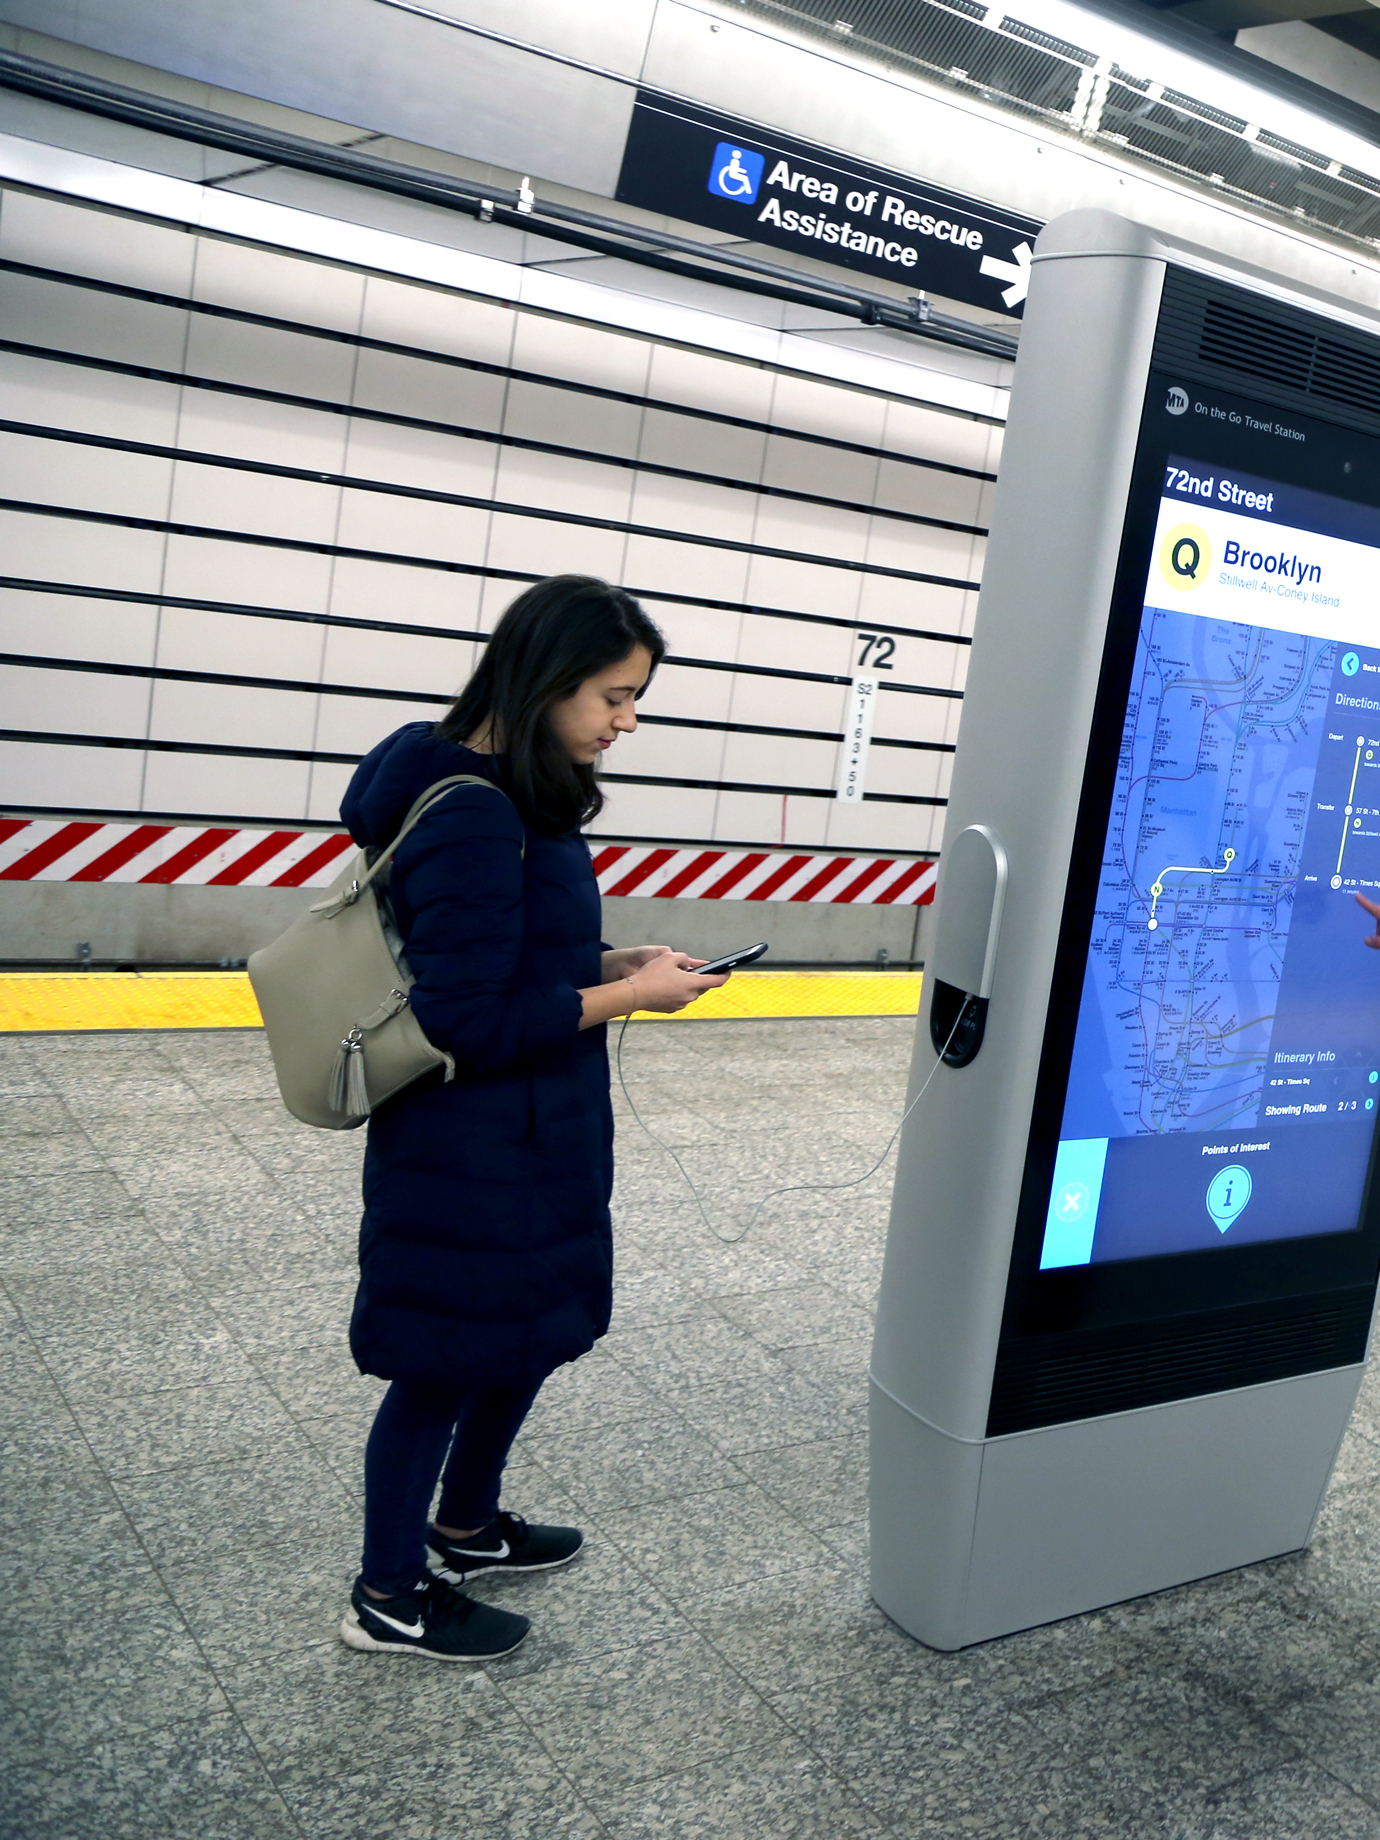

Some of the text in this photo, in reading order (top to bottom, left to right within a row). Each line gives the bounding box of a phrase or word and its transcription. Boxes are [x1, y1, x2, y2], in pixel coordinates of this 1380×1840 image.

[767, 161, 983, 251] Area of Rescue
[758, 199, 919, 267] Assistance
[1194, 402, 1306, 442] On the Go Travel Station
[1165, 466, 1274, 513] 72nd Street
[1171, 537, 1200, 580] Q
[1223, 540, 1323, 586] Brooklyn
[1218, 572, 1258, 591] Stillwell
[1311, 590, 1341, 609] Island
[1217, 625, 1230, 635] The
[1211, 635, 1232, 645] Bronx
[857, 632, 897, 670] 72
[1362, 663, 1377, 673] Back
[1328, 732, 1344, 741] Depart
[1368, 738, 1380, 746] 72nd
[1160, 806, 1196, 816] Manhattan
[1317, 802, 1335, 811] Transfer
[1374, 880, 1380, 888] Sq
[1274, 1050, 1336, 1065] Itinerary Info
[1303, 1078, 1310, 1086] Sq
[1265, 1105, 1302, 1116] Showing
[1302, 1103, 1327, 1114] Route
[1351, 1101, 1357, 1110] 3
[1202, 1142, 1271, 1156] Points of Interest
